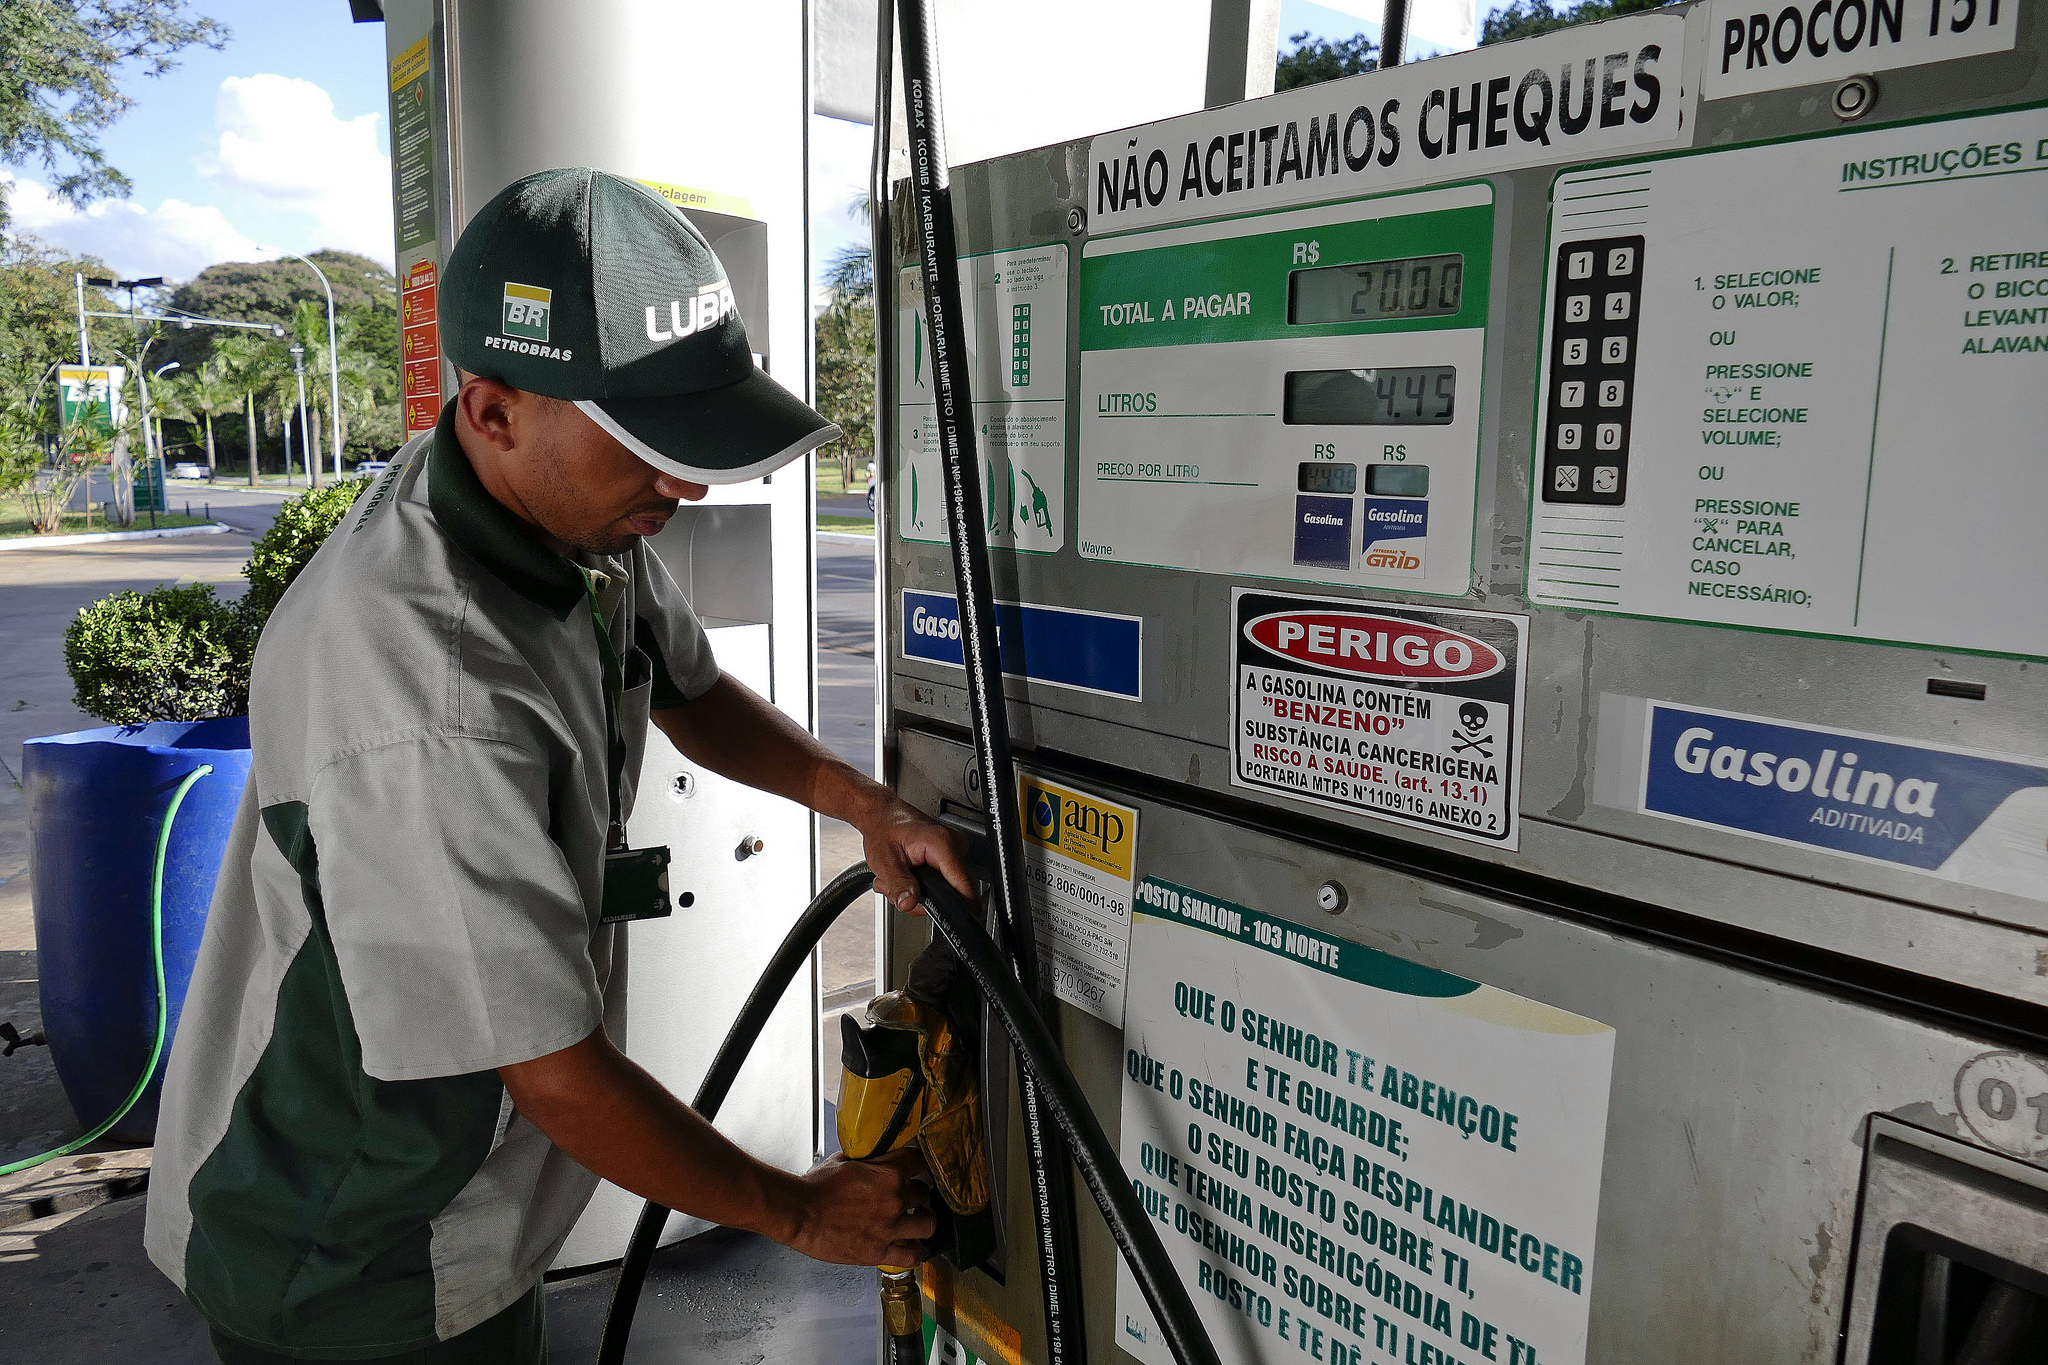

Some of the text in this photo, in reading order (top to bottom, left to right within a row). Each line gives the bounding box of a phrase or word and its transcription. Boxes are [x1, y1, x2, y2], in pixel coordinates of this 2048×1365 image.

[1721, 0, 1905, 74] PROCON
[912, 78, 926, 129] KORAX
[1097, 44, 1662, 215] NÃO ACEITAMOS CHEQUES
[915, 138, 930, 185] KCOMB
[1841, 141, 2023, 183] INSTRUÇÕES
[653, 186, 707, 204] iclagem
[922, 194, 939, 282] KARBURANTE
[1292, 240, 1320, 265] R$
[1615, 253, 1627, 271] 2
[1940, 250, 2048, 274] 2. RETIRE
[1578, 257, 1586, 274] 1
[994, 272, 1001, 285] 2
[1694, 267, 1821, 291] 1. SELECIONE
[1967, 279, 2048, 300] O BICO
[1099, 291, 1251, 326] TOTAL A PAGAR
[1573, 300, 1584, 317] 3
[1612, 298, 1624, 314] 4
[1712, 290, 1800, 310] O VALOR;
[507, 302, 544, 328] BR
[931, 296, 947, 359] PORTARIA
[484, 336, 573, 362] PETROBRAS
[1609, 341, 1620, 358] 6
[1709, 330, 1736, 346] OU
[1570, 343, 1581, 360] 5
[1705, 362, 1814, 379] PRESSIONE
[939, 360, 954, 417] INMETRO
[1567, 387, 1579, 402] 7
[1606, 385, 1617, 402] 8
[1750, 386, 1762, 401] E
[1098, 392, 1157, 412] LITROS
[1702, 407, 1809, 423] SELECIONE
[913, 429, 918, 439] 3
[946, 425, 959, 463] DIMEL
[1564, 428, 1575, 445] 9
[1604, 428, 1615, 445] 0
[1701, 430, 1782, 448] VOLUME;
[1314, 443, 1335, 461] R$
[1383, 443, 1406, 463] R$
[1097, 462, 1200, 478] PREÇO POR LITRO
[1698, 465, 1724, 481] OU
[351, 464, 403, 534] PETROBRAS
[1694, 498, 1800, 517] PRESSIONE
[1303, 512, 1344, 526] Gasolina
[1367, 507, 1423, 524] Gasolina
[1736, 519, 1784, 536] PARA
[1081, 541, 1113, 557] Wayne
[1692, 536, 1796, 560] CANCELAR,
[1690, 558, 1741, 576] CASO
[1688, 581, 1812, 608] NECESSÁRIO;
[1277, 620, 1473, 672] PERIGO
[1246, 671, 1431, 720] A GASOLINA CONTÉM
[1245, 719, 1499, 785] SUBSTÂNCIA CANCERÍGENA
[1253, 743, 1488, 806] RISCO À SAÚDE. (art. 13.1)
[1673, 726, 1940, 818] Gasolina
[1246, 761, 1309, 788] PORTARIA
[1312, 776, 1349, 797] MTPS
[1428, 802, 1482, 827] ANEXO
[1487, 813, 1497, 831] 2
[1064, 800, 1124, 855] anp
[1809, 806, 1925, 845] ADITIVADA
[1135, 881, 1179, 913] POSTO
[1181, 894, 1241, 935] SHALOM
[1286, 930, 1340, 969] NORTE
[1053, 967, 1074, 989] 970
[1076, 978, 1106, 1003] 0267
[1174, 981, 1519, 1153] QUE O SENHOR TE ABENÇOE
[1025, 1080, 1042, 1158] KARBURANTE
[1246, 1057, 1409, 1163] E TE GUARDE;
[1126, 1048, 1584, 1296] QUE O SENHOR FAÇA RESPLANDECER
[1036, 1168, 1051, 1224] PORTARIA
[1187, 1122, 1475, 1300] O SEU ROSTO SOBRE TI,
[1042, 1227, 1056, 1276] INMETRO
[1140, 1141, 1179, 1188] QUE
[1183, 1162, 1253, 1229] TENHA
[1259, 1203, 1453, 1339] MISERICÓRDIA
[1459, 1310, 1499, 1363] DE
[1506, 1333, 1540, 1365] TI
[1132, 1179, 1170, 1225] QUE
[1283, 1264, 1366, 1340] SOBRE
[1372, 1313, 1398, 1358] TI
[1048, 1283, 1060, 1317] DIMEL
[1198, 1258, 1272, 1328] ROSTO
[1278, 1306, 1291, 1341] E
[1296, 1317, 1324, 1362] TE
